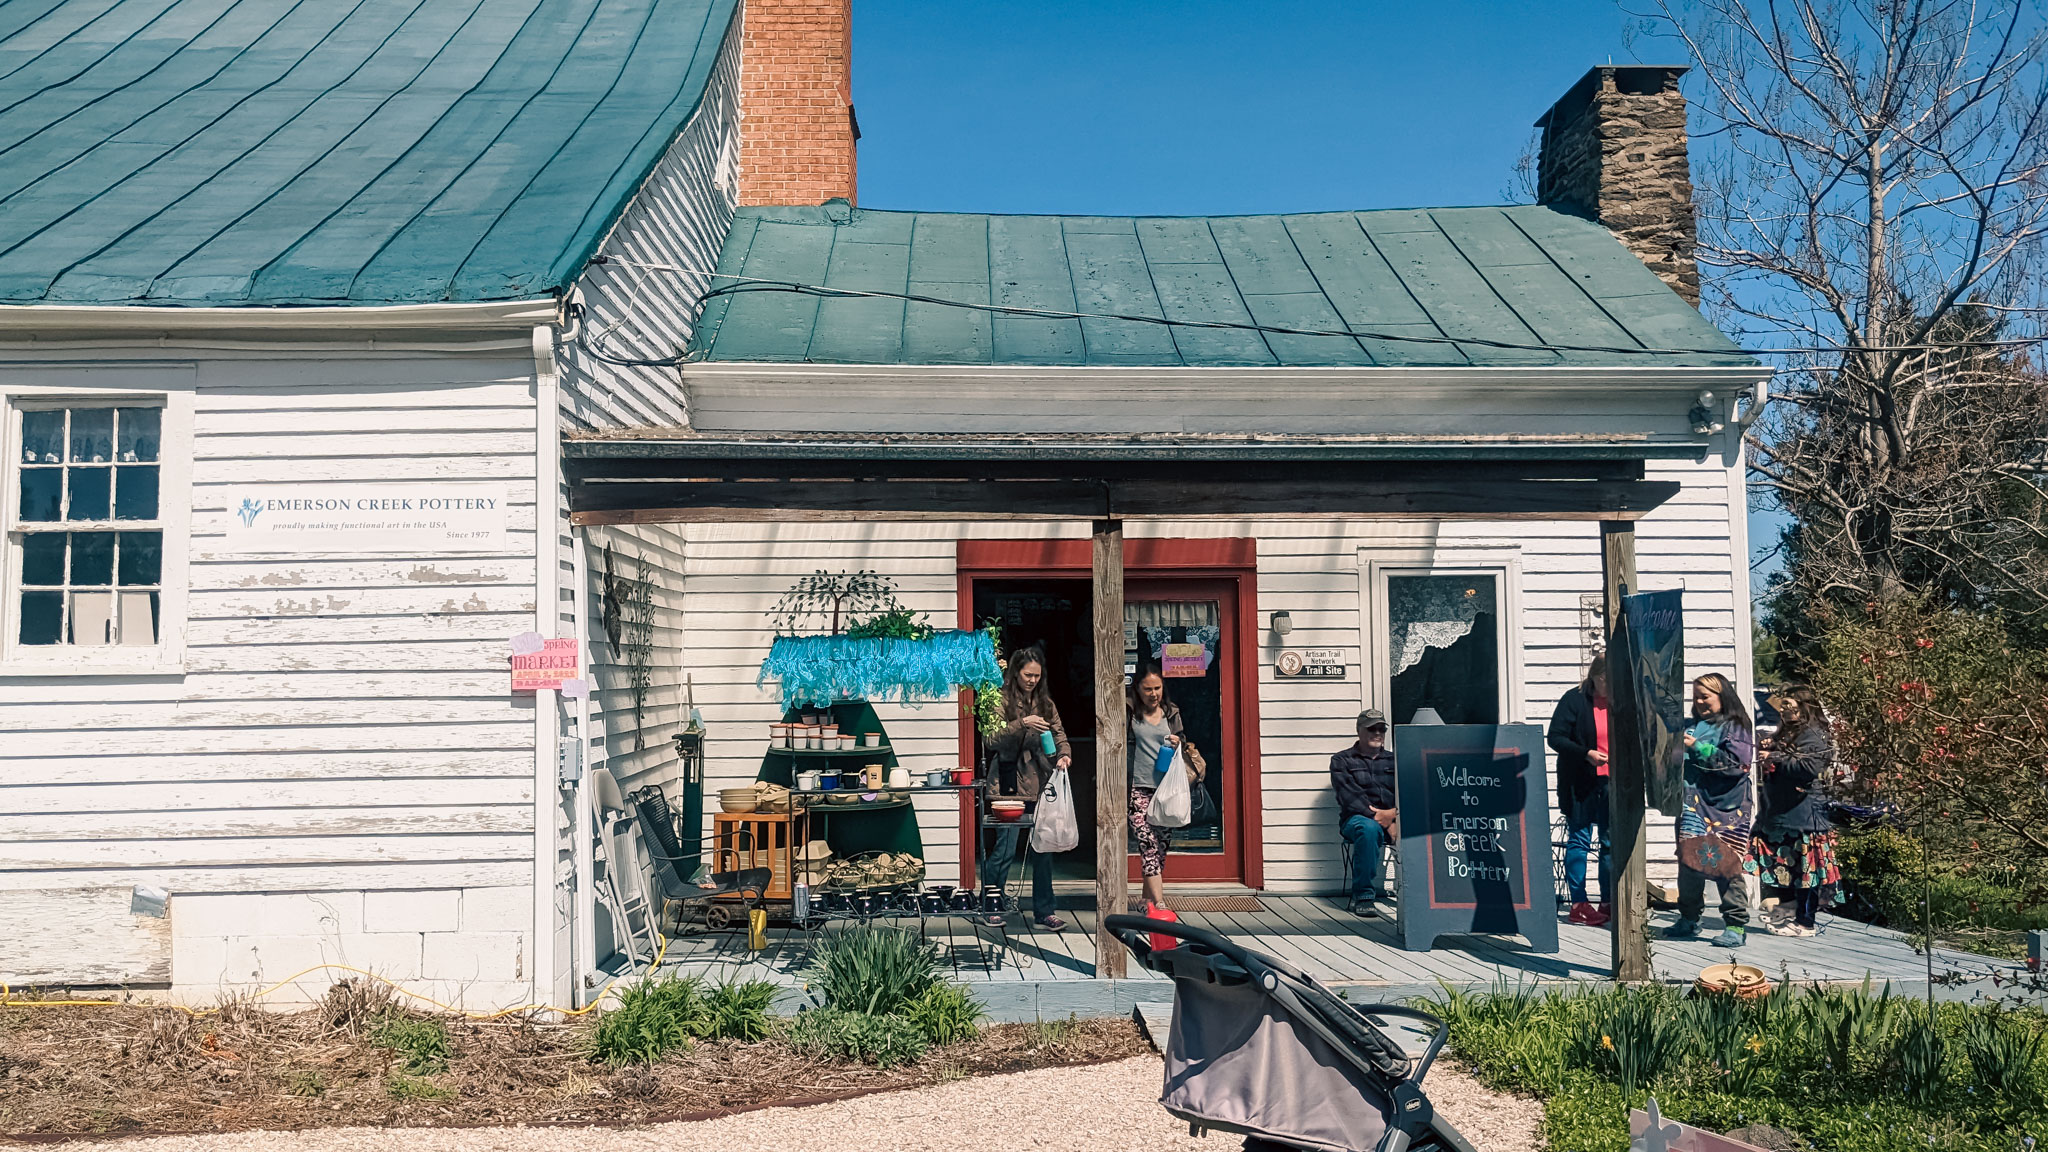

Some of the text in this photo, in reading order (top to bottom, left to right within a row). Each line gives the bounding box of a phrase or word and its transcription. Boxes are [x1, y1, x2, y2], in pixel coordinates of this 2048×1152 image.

[267, 498, 497, 511] EMERSON CREEK POTTERY
[272, 522, 306, 532] proudly
[308, 522, 339, 531] making
[340, 521, 385, 532] functional
[413, 521, 427, 529] the
[429, 521, 448, 529] USA
[446, 531, 491, 539] Since 1977
[1305, 666, 1343, 675] Trail Site
[1436, 766, 1502, 787] Welcome
[1461, 790, 1479, 806] to
[1442, 812, 1508, 831] Emerson
[1444, 832, 1507, 852] Creek
[1448, 856, 1510, 881] Pottery
